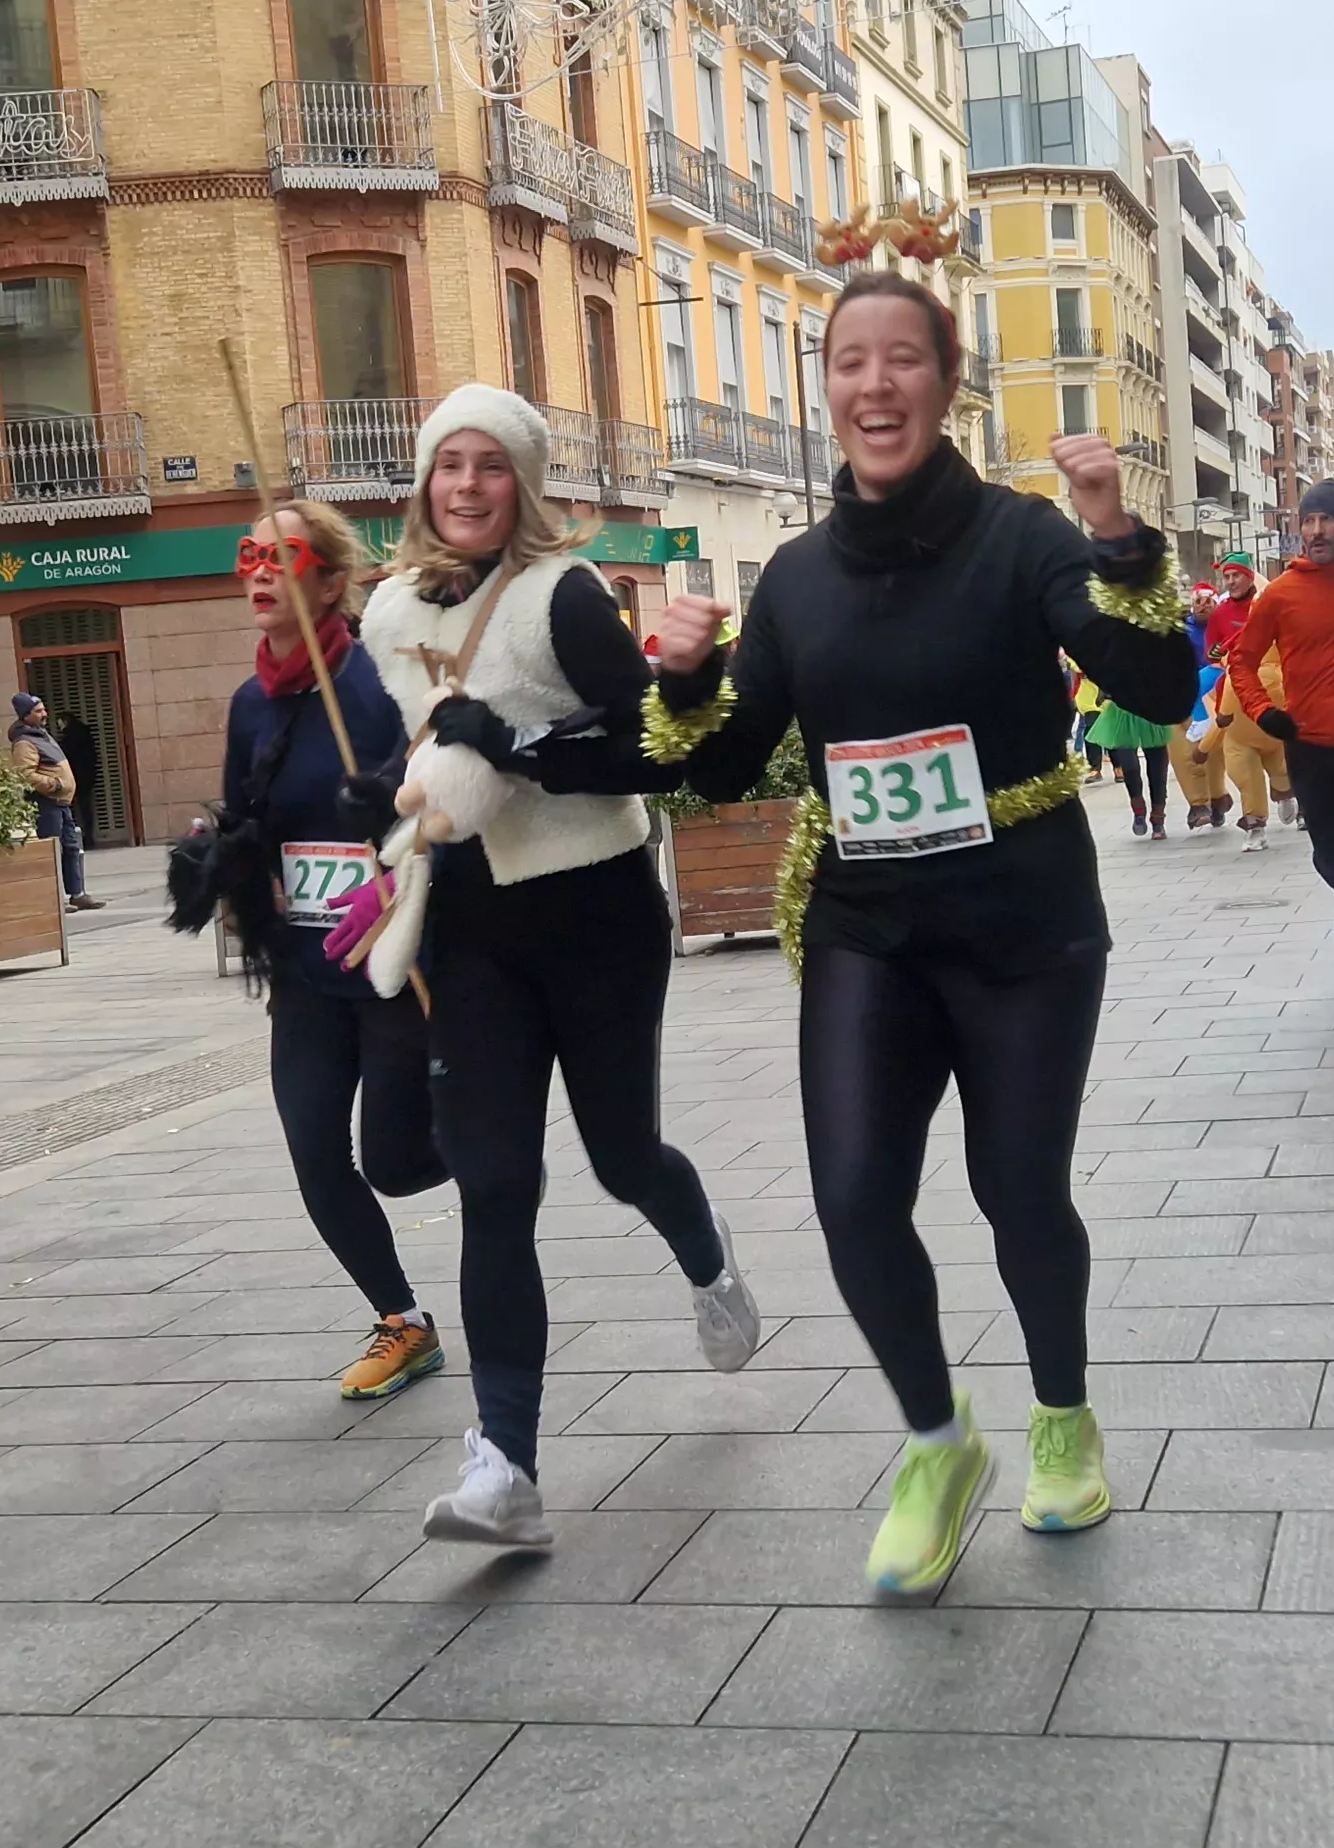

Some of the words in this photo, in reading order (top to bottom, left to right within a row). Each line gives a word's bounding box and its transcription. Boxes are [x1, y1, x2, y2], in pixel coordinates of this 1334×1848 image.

[167, 457, 191, 466] CALLE
[31, 550, 73, 566] CAJA
[76, 545, 132, 562] RURAL
[44, 568, 62, 580] DE
[65, 562, 122, 578] ARAGÓN
[848, 752, 971, 825] 331
[293, 858, 365, 901] 272
